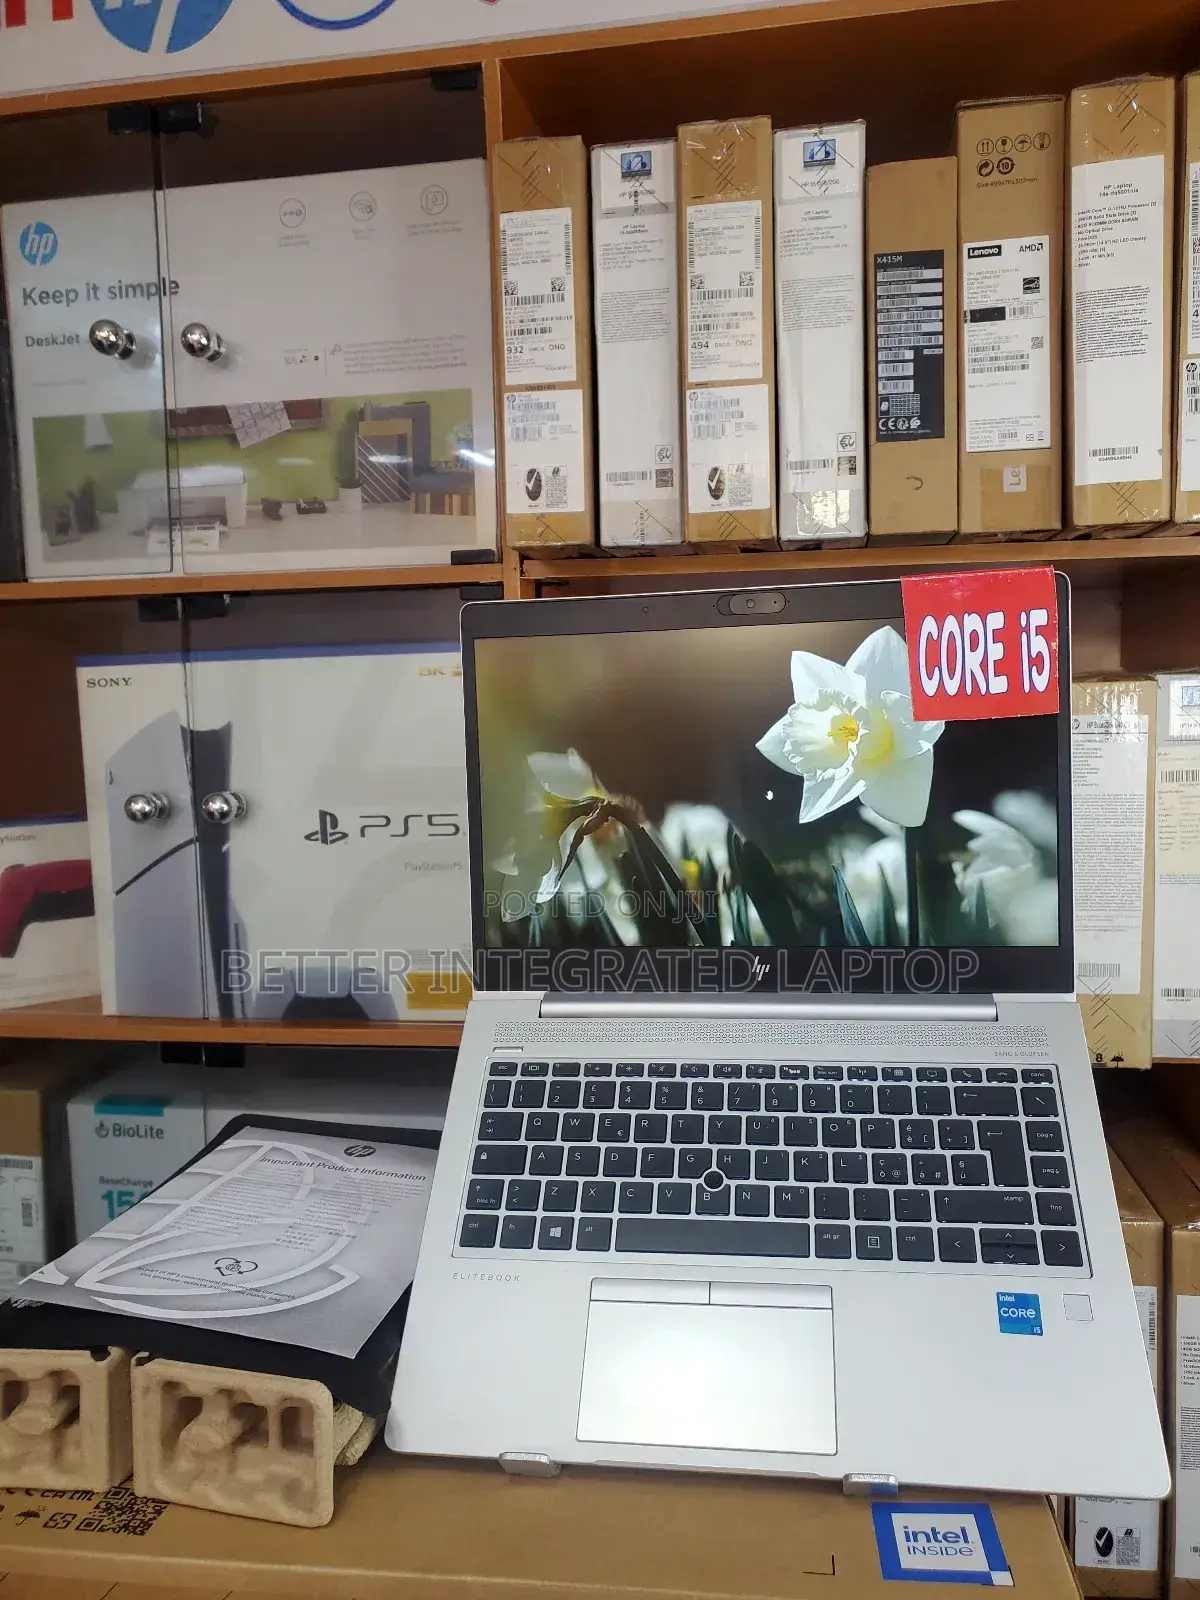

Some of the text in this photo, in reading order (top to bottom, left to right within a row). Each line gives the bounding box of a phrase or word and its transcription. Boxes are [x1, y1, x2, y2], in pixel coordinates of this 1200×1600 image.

[1001, 162, 1009, 170] 10
[1113, 182, 1133, 190] Laptop
[970, 246, 999, 256] Lenovo
[1019, 244, 1037, 253] AMD
[877, 255, 903, 264] X415M
[22, 277, 180, 308] Keep it simple
[25, 333, 81, 348] DeskJet
[691, 339, 753, 350] 494 ONG
[506, 343, 566, 355] 932 ONG
[918, 608, 1051, 697] CORE i5
[86, 677, 132, 689] SONY
[360, 814, 461, 838] PS5
[533, 1117, 543, 1127] Q
[569, 1118, 581, 1126] W
[604, 1119, 612, 1127] E
[641, 1119, 649, 1127] R
[677, 1120, 685, 1128] T
[715, 1120, 724, 1129] Y
[753, 1121, 761, 1130] U
[112, 1122, 165, 1139] BioLite
[829, 1123, 839, 1132] O
[867, 1124, 875, 1132] P
[343, 1144, 377, 1158] hp
[537, 1152, 546, 1161] A
[574, 1152, 581, 1161] S
[611, 1153, 619, 1161] D
[648, 1153, 655, 1162] F
[686, 1154, 695, 1163] G
[724, 1155, 732, 1164] H
[763, 1156, 768, 1165] J
[801, 1157, 809, 1166] K
[840, 1158, 847, 1167] L
[260, 1157, 427, 1181] Important Product Information
[99, 1176, 154, 1188] BaseCharge
[550, 1187, 558, 1196] Z
[589, 1188, 597, 1196] X
[626, 1188, 635, 1197] C
[665, 1189, 673, 1198] V
[742, 1191, 751, 1200] N
[703, 1192, 711, 1201] B
[782, 1192, 792, 1201] M
[1003, 1195, 1024, 1203] stamp
[452, 1272, 521, 1282] ELITEBOOK
[999, 1294, 1015, 1302] intel
[1033, 1326, 1041, 1334] i5
[902, 1525, 969, 1544] intel
